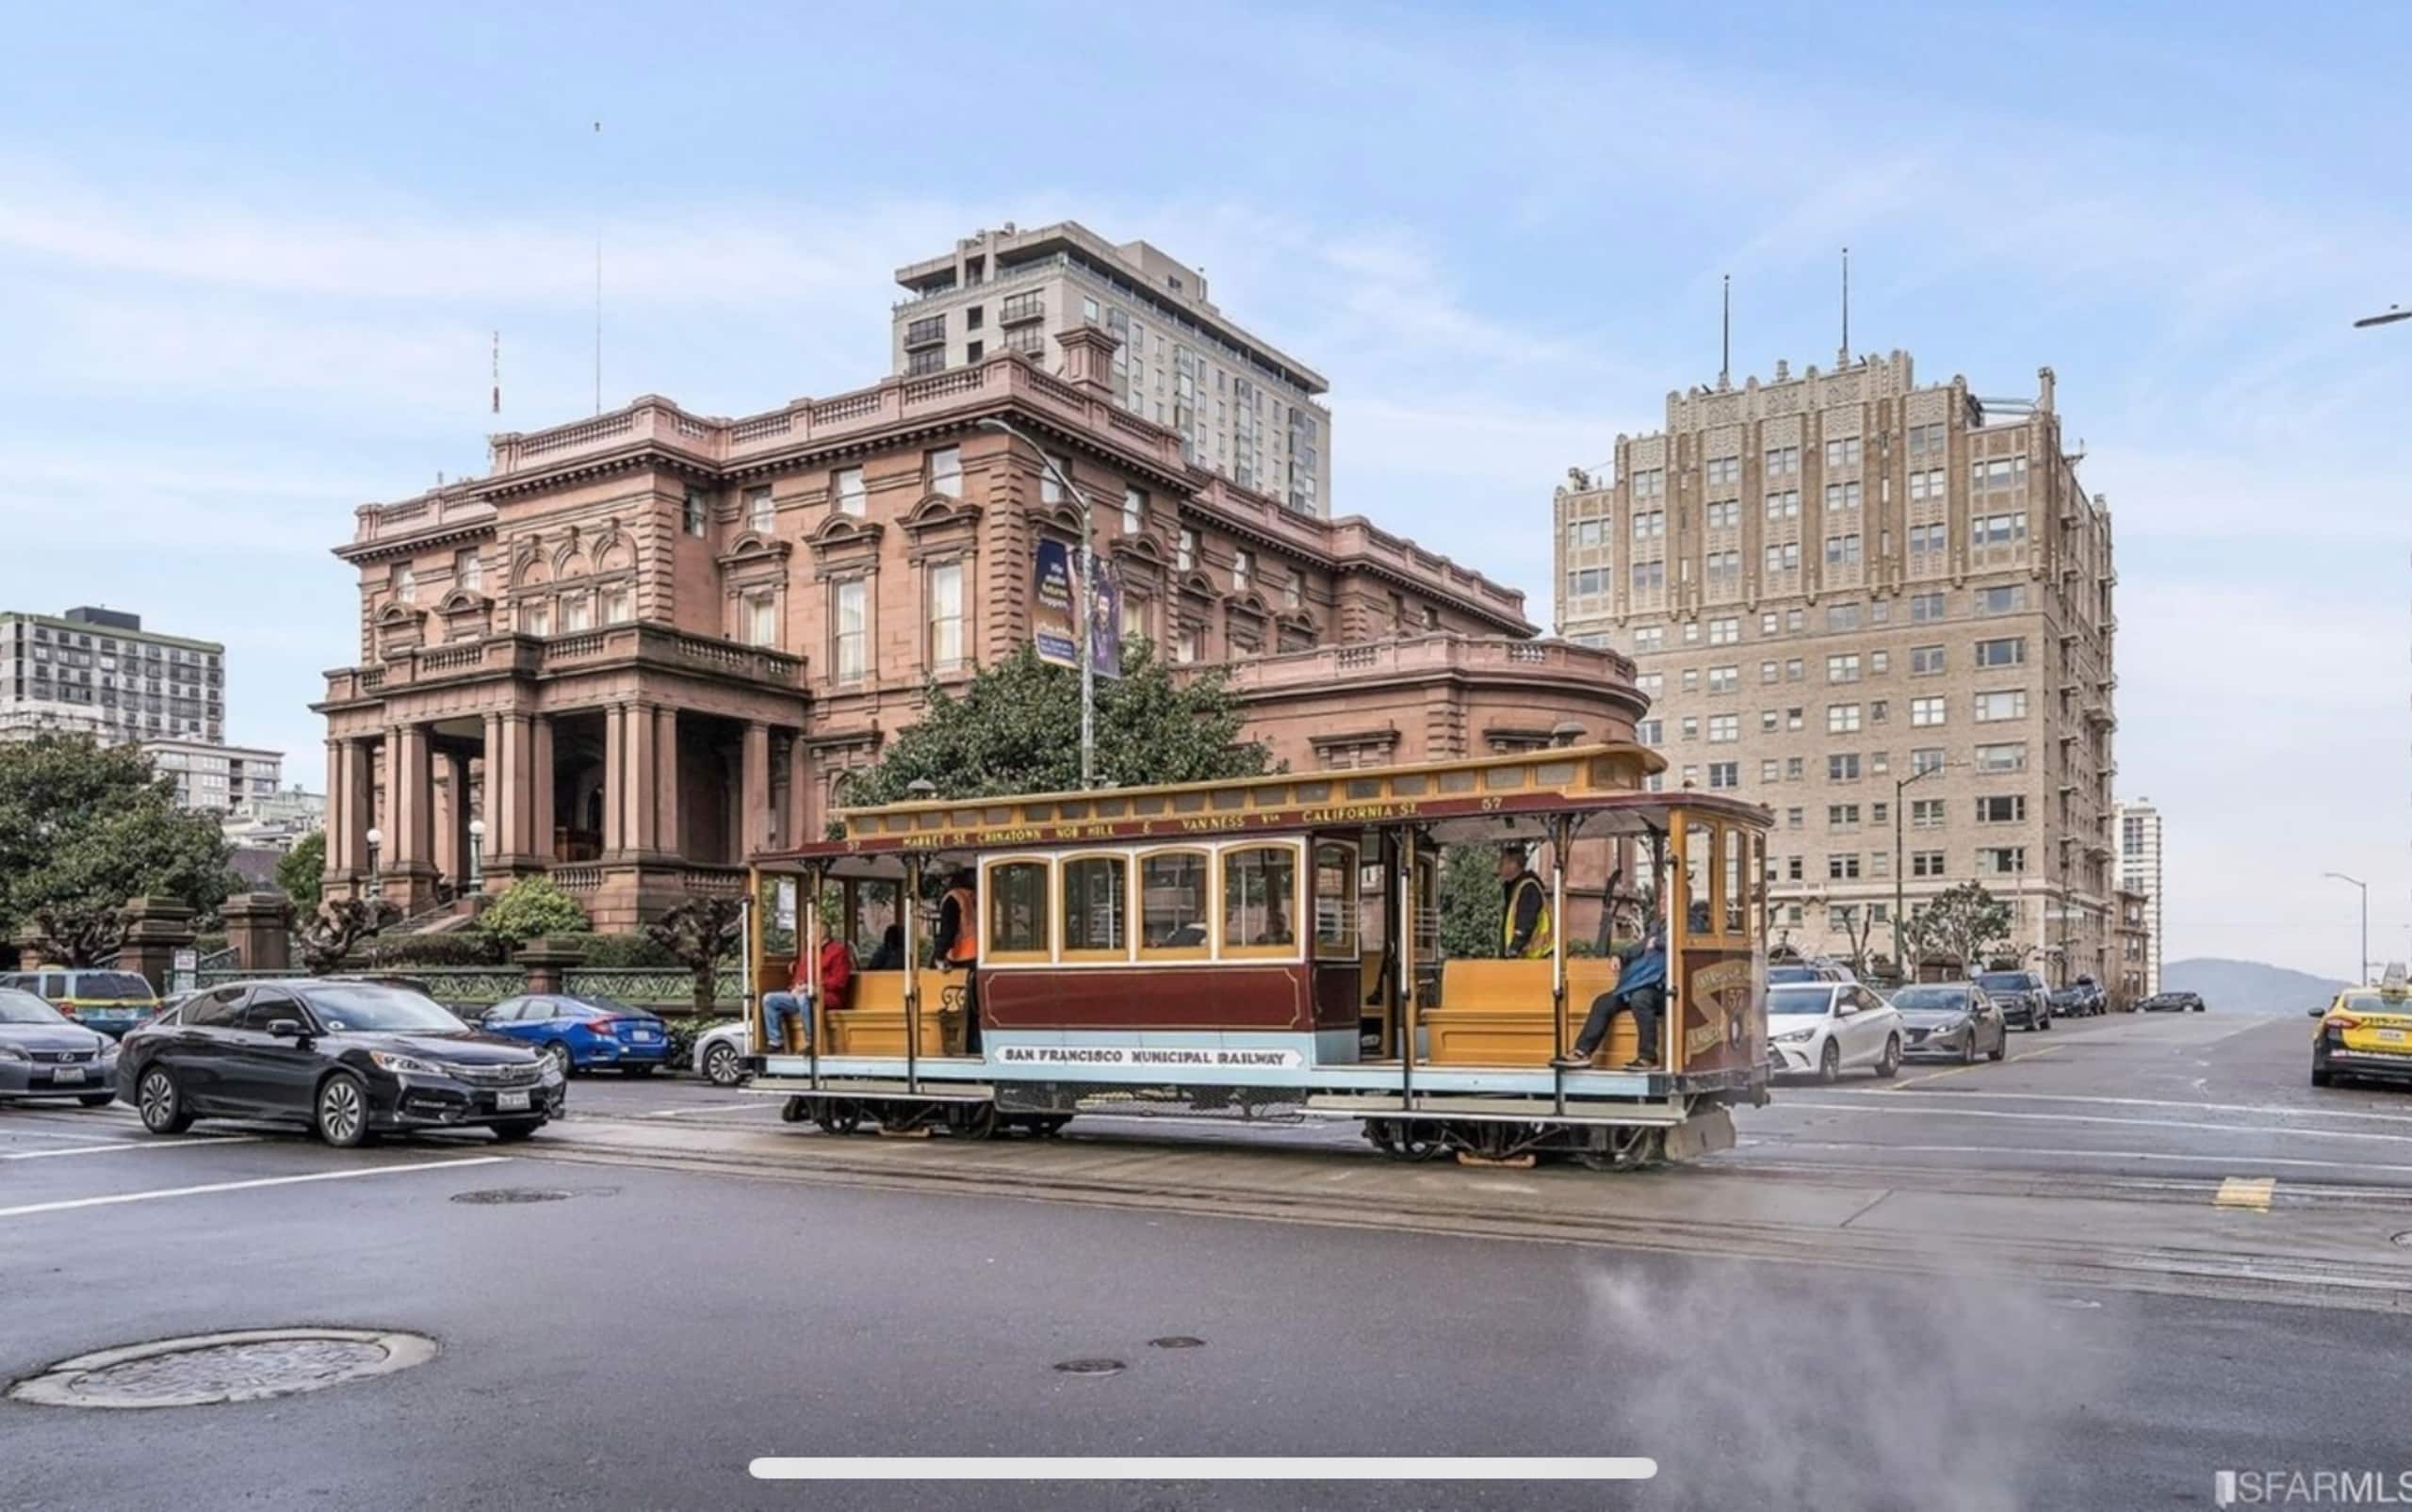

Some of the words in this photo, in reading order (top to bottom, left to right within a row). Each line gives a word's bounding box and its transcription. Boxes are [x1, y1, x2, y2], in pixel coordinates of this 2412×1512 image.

[978, 829, 1041, 843] CHINATOWN
[1056, 827, 1079, 838] NOB
[1087, 825, 1115, 837] HILL
[1302, 805, 1393, 822] CALIFORNIA
[1481, 798, 1504, 811] 57
[1004, 1048, 1035, 1061] SAN
[1038, 1049, 1124, 1063] FRANCISCO
[1132, 1048, 1213, 1064] MUNICIPAL
[1218, 1050, 1285, 1065] RAILWAY
